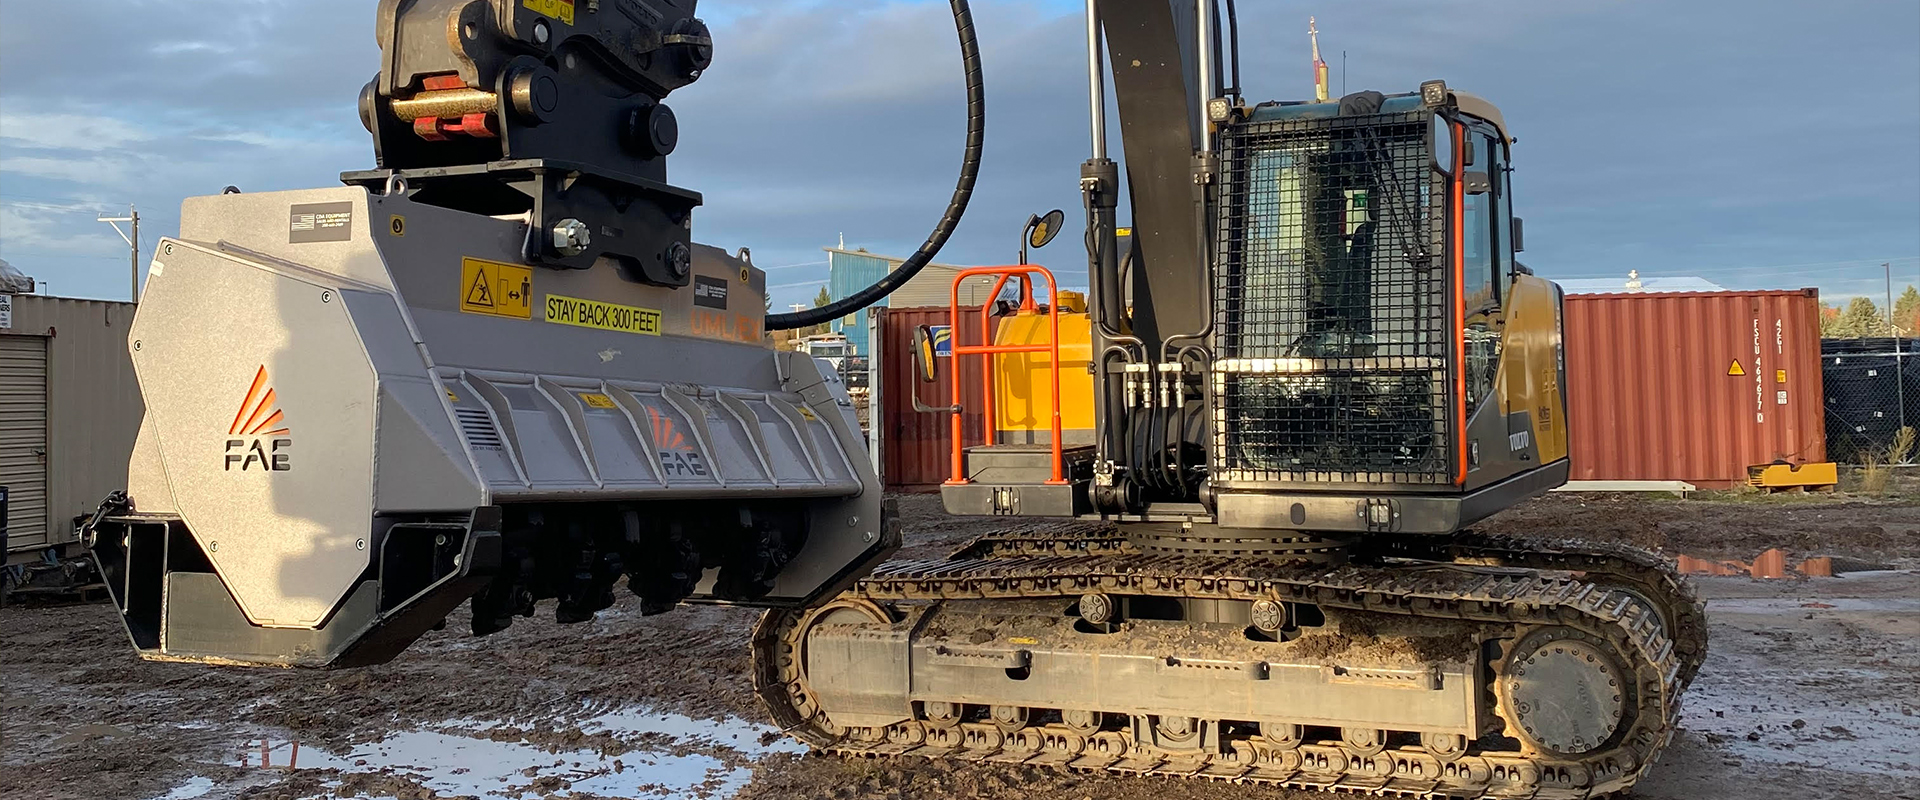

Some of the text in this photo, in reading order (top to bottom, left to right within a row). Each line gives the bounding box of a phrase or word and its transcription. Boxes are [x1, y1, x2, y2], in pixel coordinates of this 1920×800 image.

[547, 297, 660, 332] STAY BACK 300 FEET
[225, 438, 292, 471] FAE
[1509, 430, 1529, 452] VOLVO
[661, 452, 707, 476] FAE
